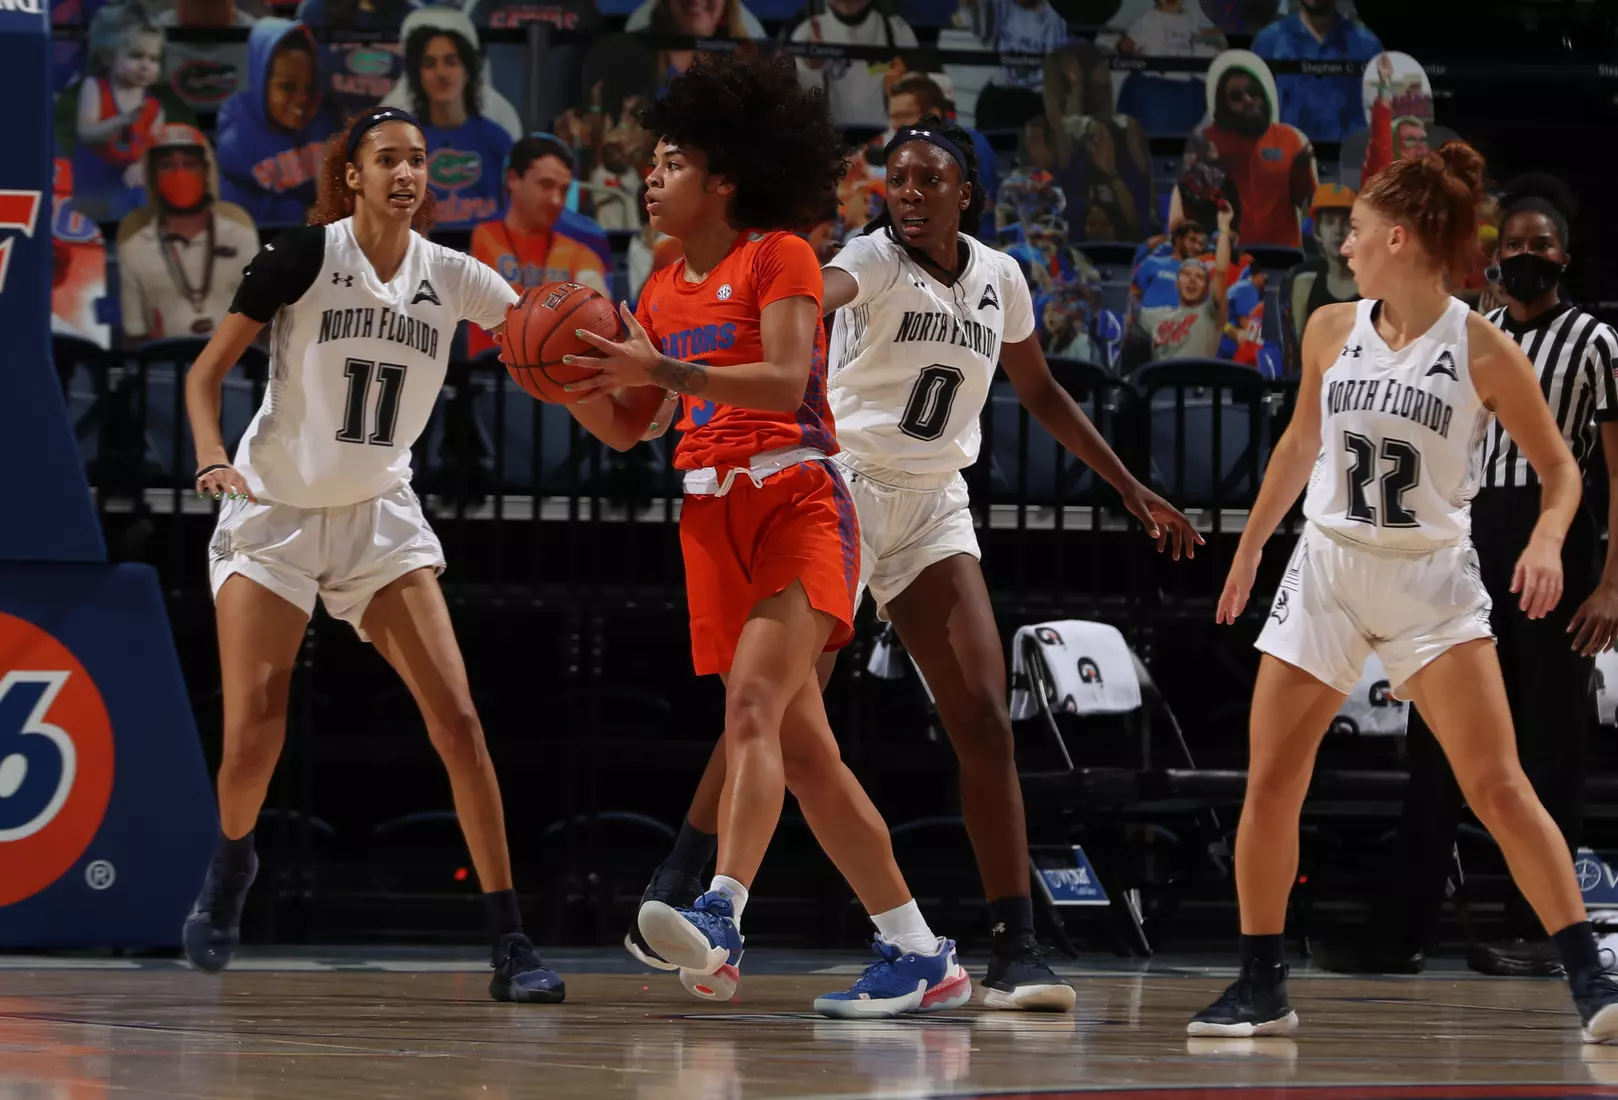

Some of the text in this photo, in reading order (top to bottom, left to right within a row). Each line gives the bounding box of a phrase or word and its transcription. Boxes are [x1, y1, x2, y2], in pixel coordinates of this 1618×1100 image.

[317, 306, 439, 360] NORTH FLORIDA
[893, 311, 948, 343] NORTH
[335, 357, 408, 447] 11
[898, 363, 965, 442] 0
[1327, 378, 1453, 439] NORTH FLORIDA
[1344, 430, 1421, 529] 22
